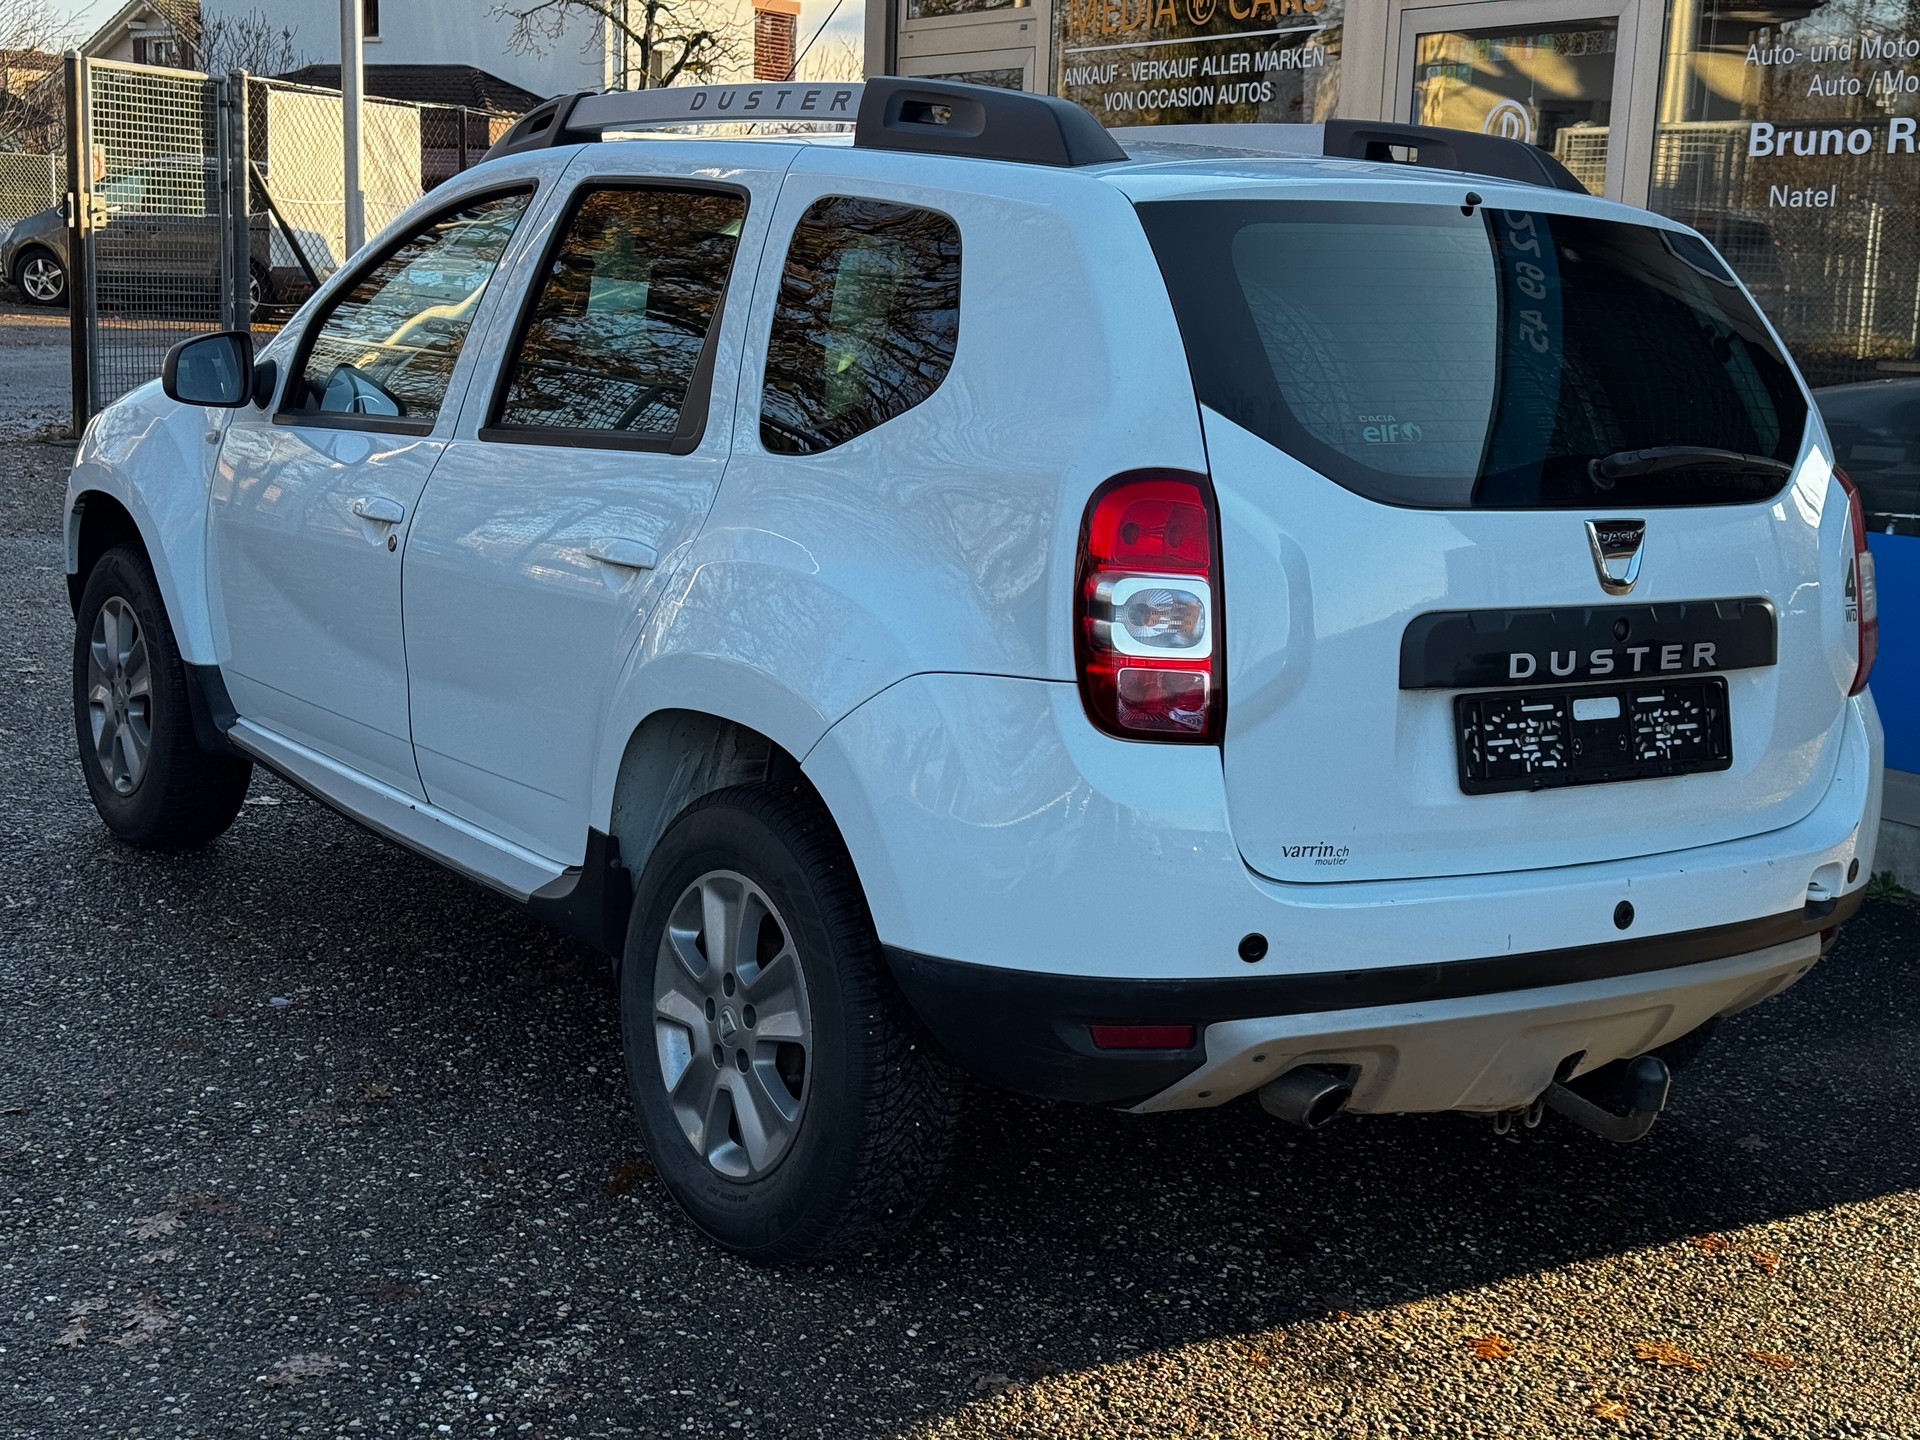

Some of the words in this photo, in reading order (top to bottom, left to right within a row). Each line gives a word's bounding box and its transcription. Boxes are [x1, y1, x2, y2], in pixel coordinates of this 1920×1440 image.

[1744, 43, 1803, 66] Auto-
[1810, 37, 1853, 62] und
[1063, 64, 1119, 87] ANKAUF
[1131, 57, 1199, 81] VERKAUF
[1201, 53, 1250, 77] ALLER
[1254, 46, 1325, 73] MARKEN
[1104, 91, 1134, 112] VON
[1137, 85, 1215, 110] OCCASION
[1217, 81, 1272, 105] AUTOS
[1806, 74, 1861, 97] Auto
[689, 90, 853, 111] DUSTER
[1749, 122, 1873, 157] Bruno
[1886, 117, 1920, 154] R
[1769, 184, 1837, 208] Natel
[1359, 415, 1397, 423] DACIA
[1363, 424, 1399, 442] elf
[1845, 558, 1857, 602] 4
[1845, 608, 1857, 622] WD
[1509, 642, 1717, 679] DUSTER
[1281, 841, 1350, 858] varrin.ch
[1314, 857, 1348, 866] moutier
